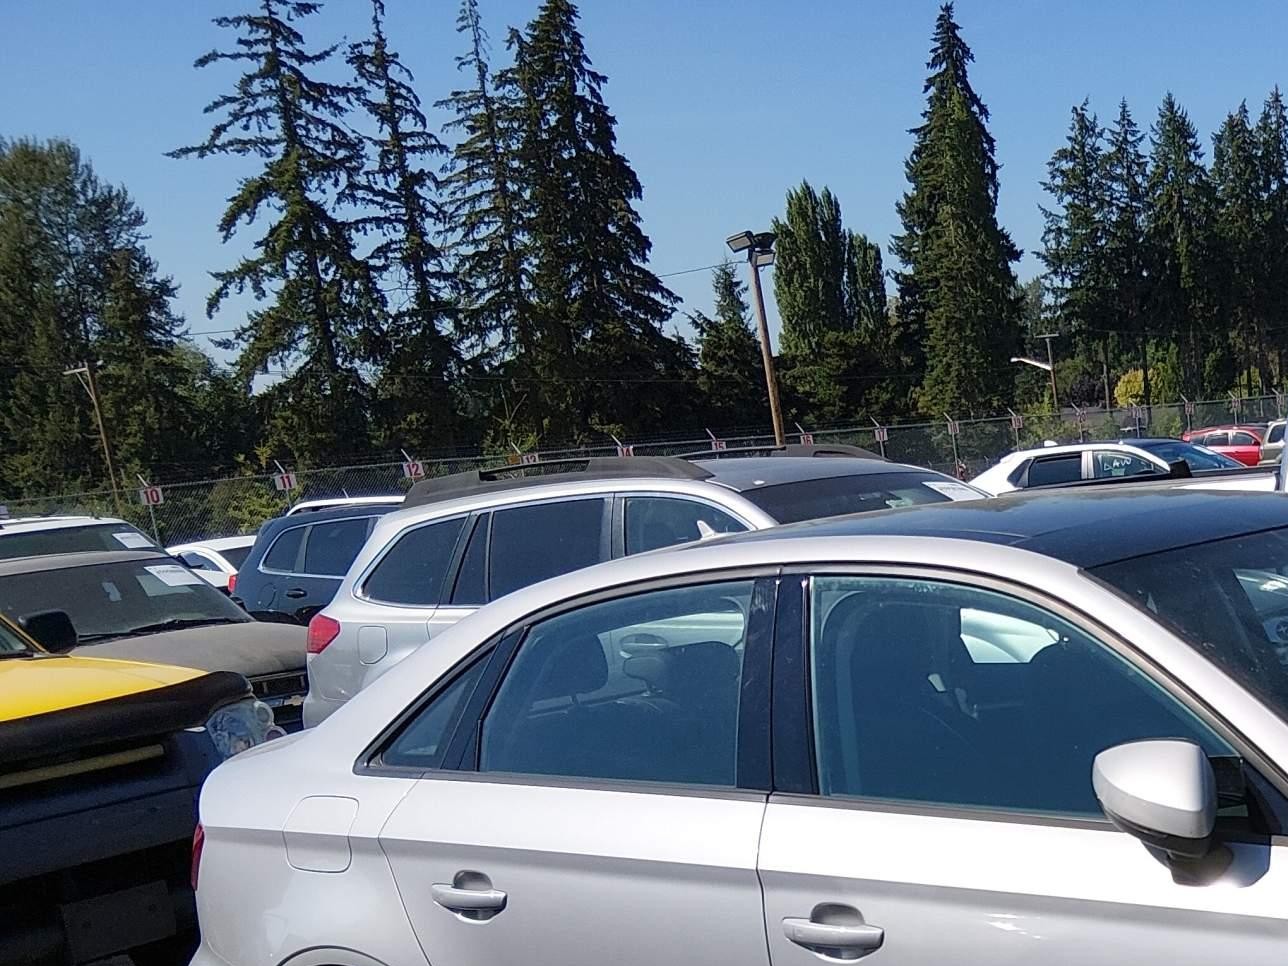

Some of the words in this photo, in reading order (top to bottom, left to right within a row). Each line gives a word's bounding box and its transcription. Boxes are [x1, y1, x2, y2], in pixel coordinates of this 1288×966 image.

[406, 463, 422, 476] 12
[279, 475, 293, 488] 11
[143, 488, 160, 504] 10
